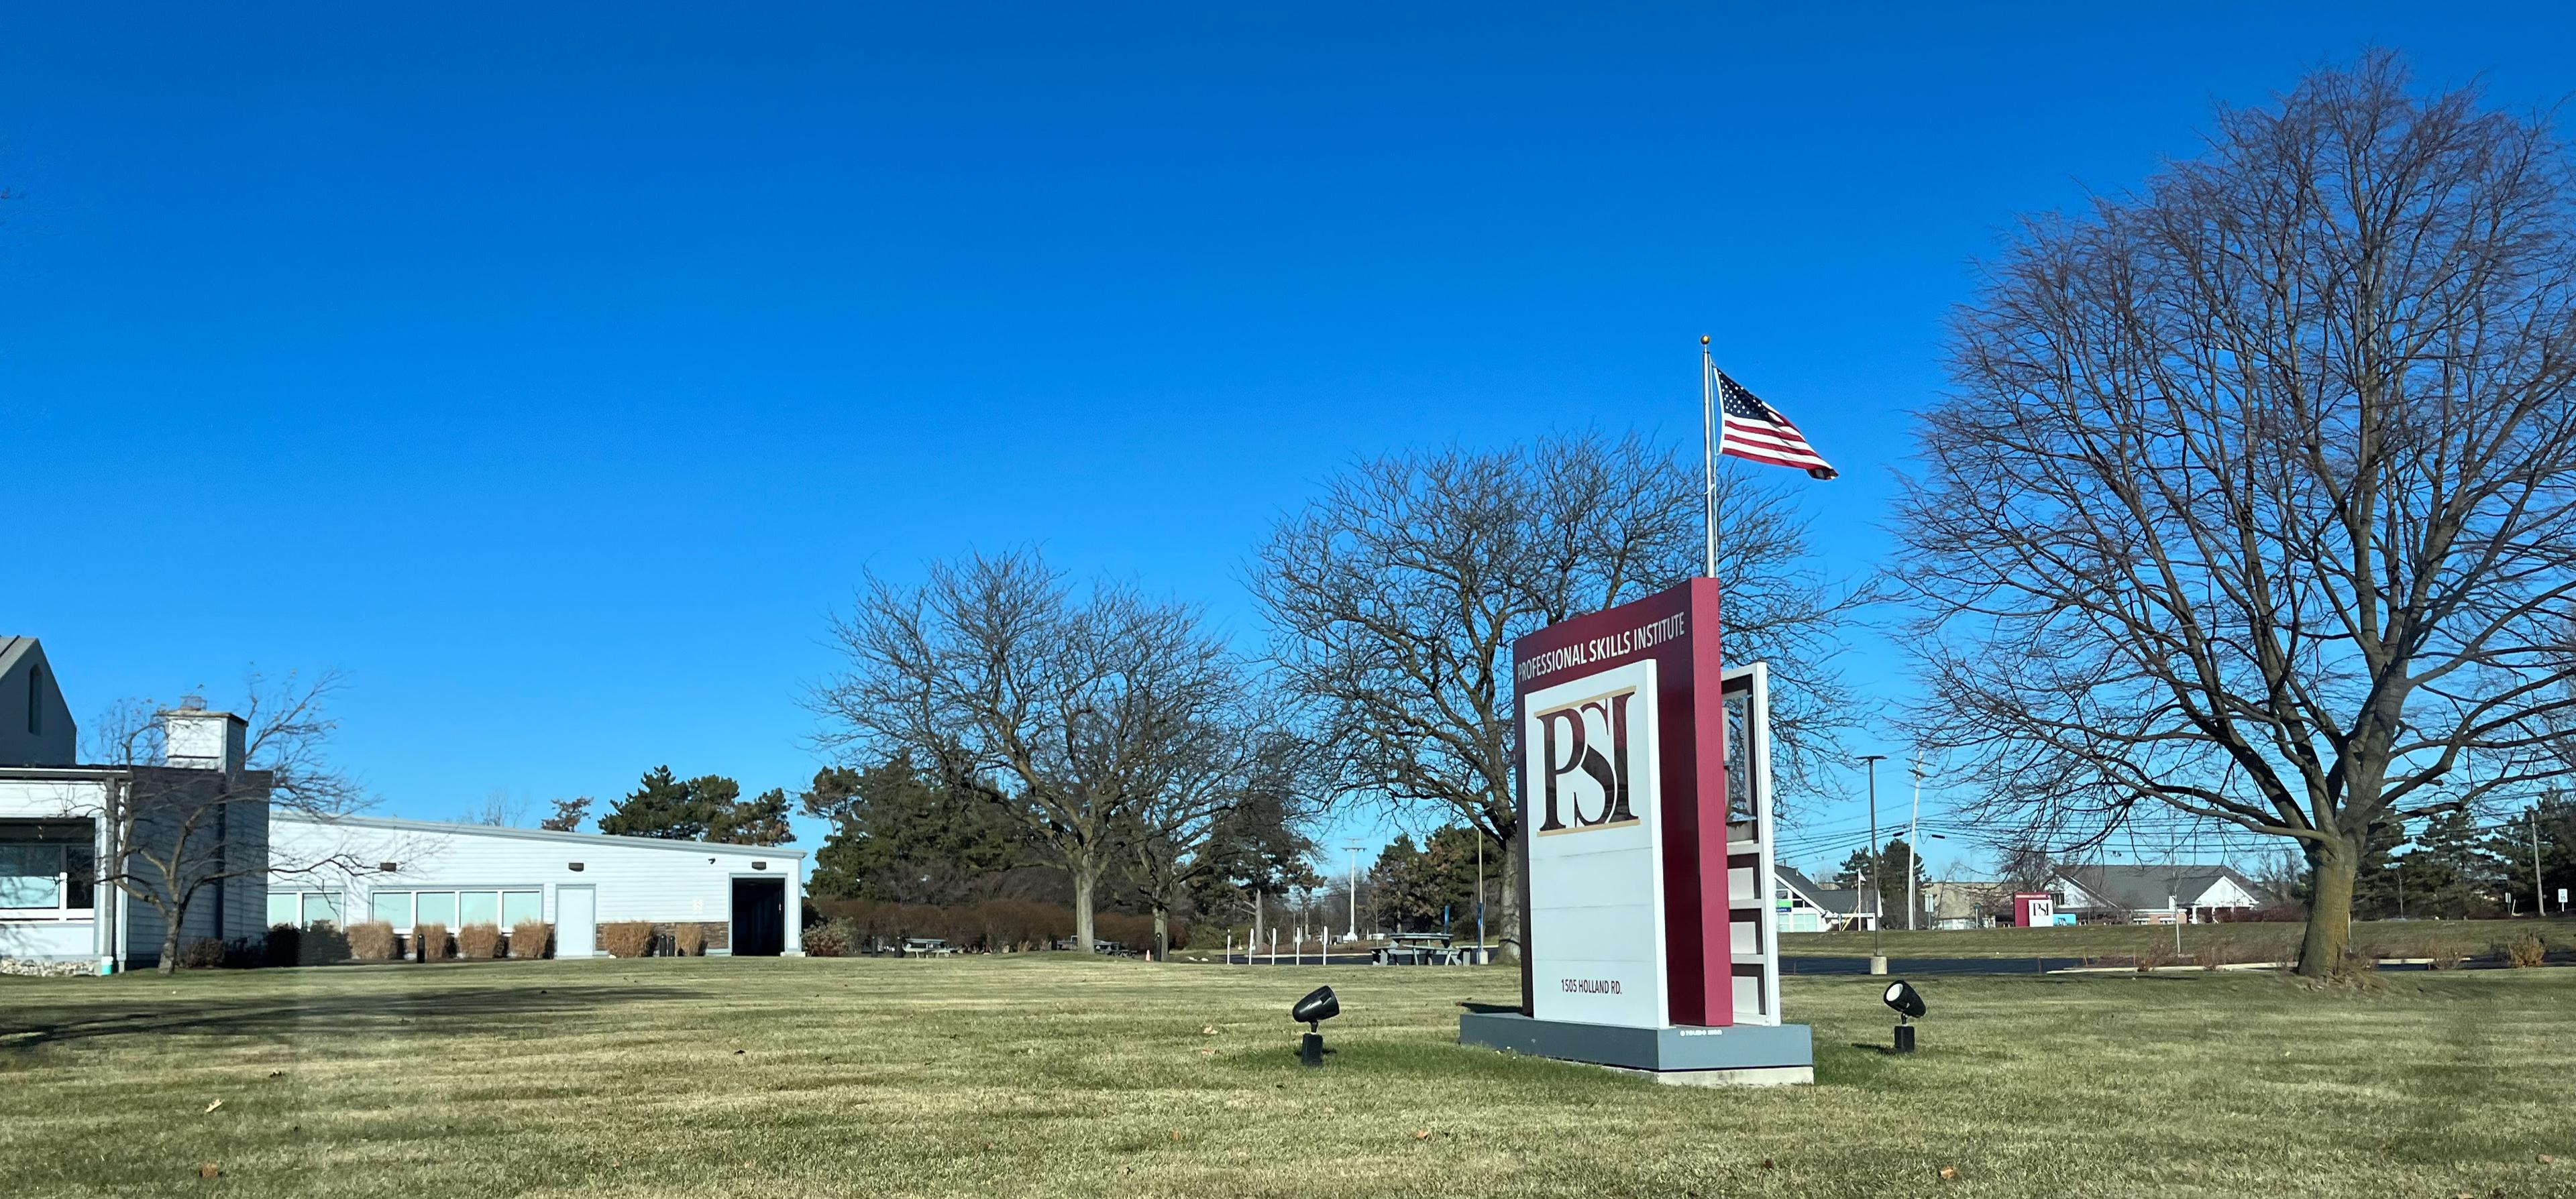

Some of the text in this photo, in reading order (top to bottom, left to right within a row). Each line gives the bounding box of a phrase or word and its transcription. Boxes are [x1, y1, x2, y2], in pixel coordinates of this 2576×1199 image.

[1517, 611, 1685, 683] PROFESSIONAL SKILLS INSTITUTE
[1536, 691, 1639, 832] PSI
[2033, 903, 2049, 917] PSI
[1561, 978, 1623, 994] 1505 HOLLAND RD.
